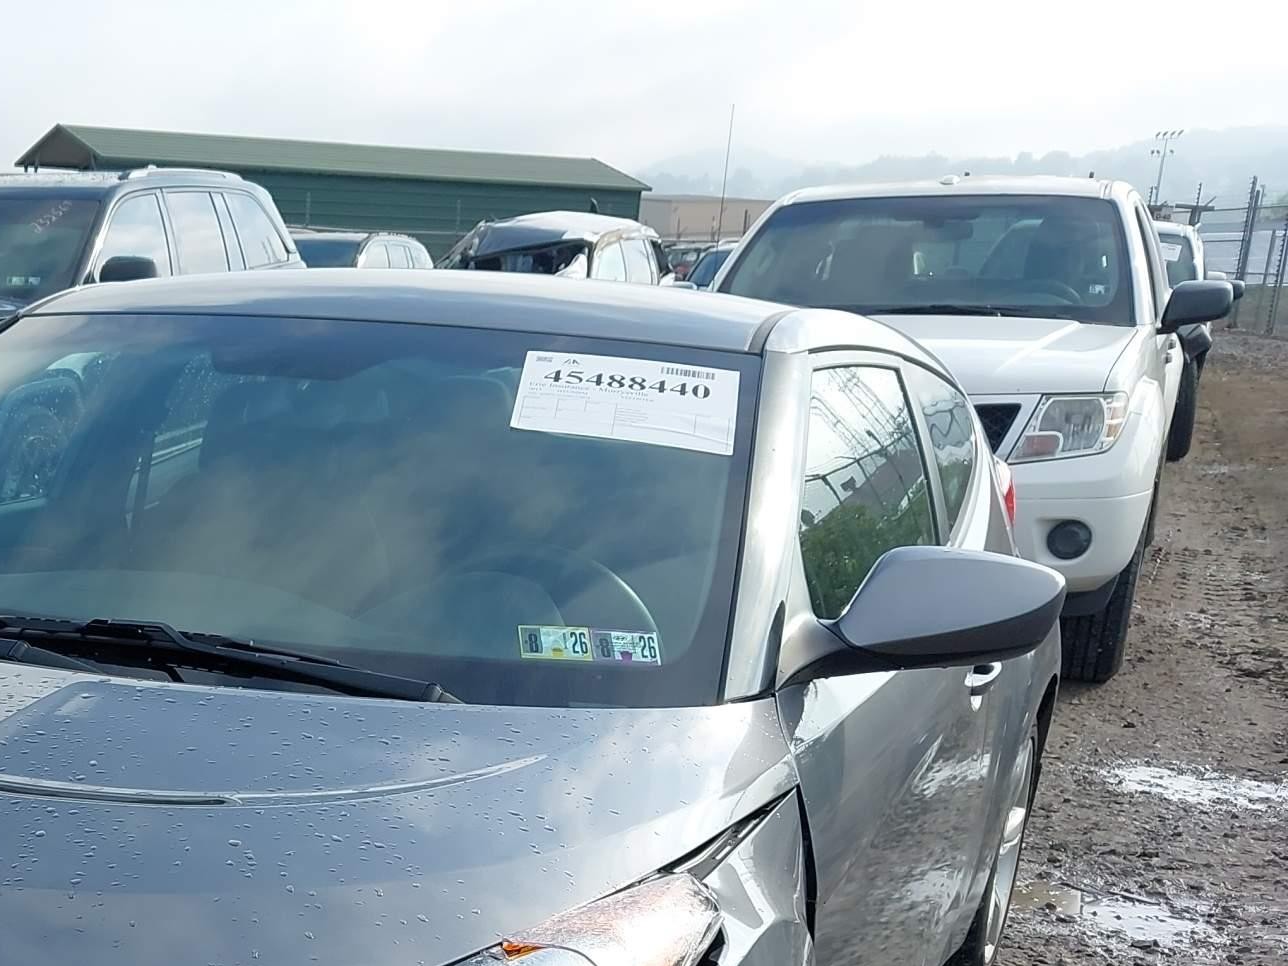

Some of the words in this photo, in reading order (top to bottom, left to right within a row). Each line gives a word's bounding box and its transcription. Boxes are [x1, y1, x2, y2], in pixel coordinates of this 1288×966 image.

[543, 369, 710, 399] 45488440
[569, 632, 589, 654] 26
[638, 635, 657, 659] 26
